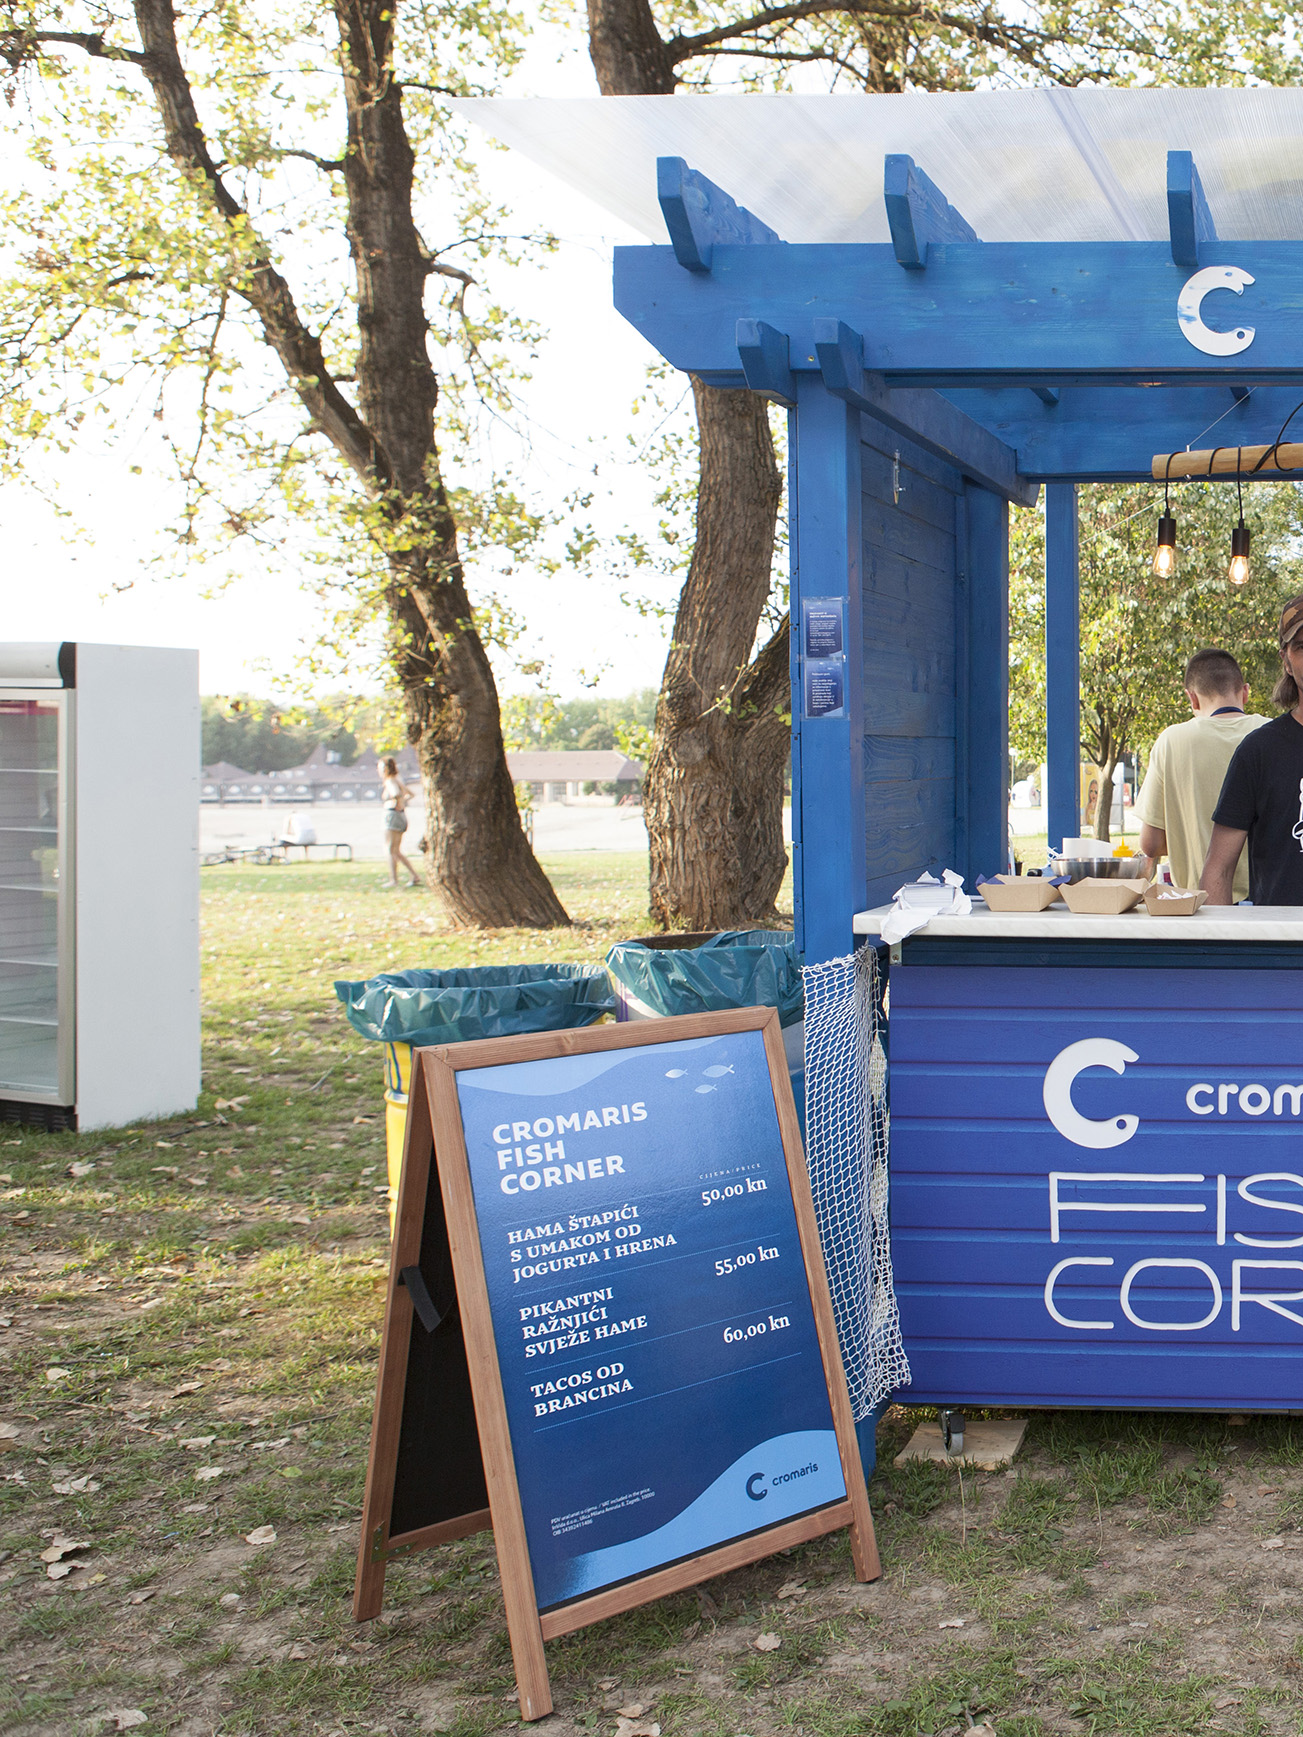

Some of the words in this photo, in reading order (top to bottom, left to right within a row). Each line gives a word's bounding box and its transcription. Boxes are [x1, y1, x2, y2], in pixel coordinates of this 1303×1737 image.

[492, 1102, 648, 1144] CROMARIS
[497, 1140, 566, 1171] FISH
[699, 1163, 761, 1179] CIJENA/PRICE
[500, 1155, 626, 1195] CORNER
[701, 1184, 744, 1206] 50,00
[745, 1177, 768, 1193] kn
[507, 1222, 565, 1244] HAMA
[568, 1204, 639, 1232] ŠTAPIĆI
[511, 1249, 521, 1263] S
[526, 1230, 611, 1259] UMAKOM
[614, 1224, 642, 1239] OD
[512, 1251, 600, 1284] JOGURTA
[603, 1248, 611, 1260] I
[614, 1234, 678, 1258] HRENA
[715, 1252, 756, 1276] 55,00
[757, 1246, 780, 1261] kn
[519, 1287, 614, 1321] PIKANTNI
[522, 1305, 608, 1339] RAŽNJIĆI
[525, 1329, 590, 1358] SVJEŽE
[594, 1315, 648, 1340] HAME
[723, 1322, 767, 1344] 60,00
[768, 1315, 791, 1331] kn
[530, 1370, 593, 1398] TACOS
[596, 1362, 624, 1379] OD
[534, 1379, 634, 1417] BRANCINA
[772, 1462, 819, 1486] cromaris
